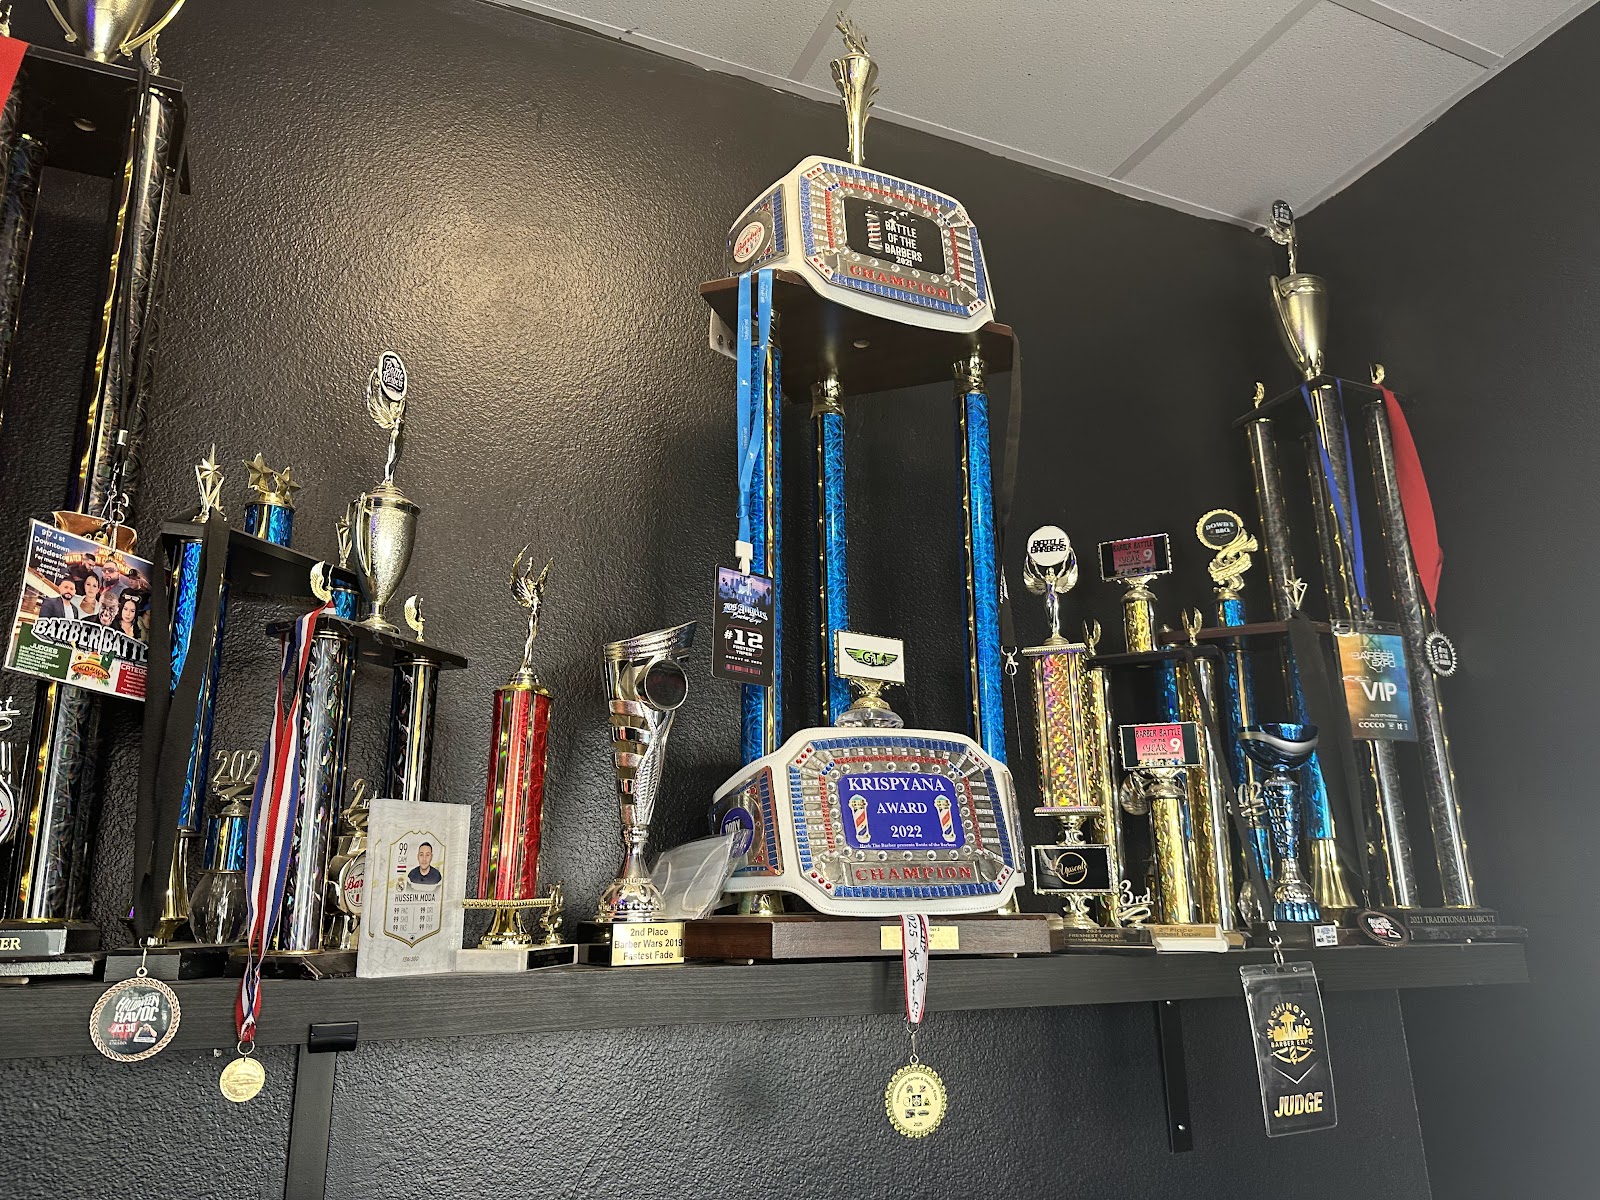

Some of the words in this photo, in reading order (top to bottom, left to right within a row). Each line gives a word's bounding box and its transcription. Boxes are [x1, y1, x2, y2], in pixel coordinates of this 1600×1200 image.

[884, 219, 917, 239] BATTLE
[887, 232, 899, 244] OF
[899, 235, 917, 249] THE
[884, 242, 923, 262] BARBERS
[896, 256, 913, 267] 2021
[850, 265, 949, 299] CHAMPION
[34, 536, 70, 553] Downtown
[1133, 540, 1153, 549] BATTLE
[35, 545, 67, 561] Modesto
[1143, 548, 1153, 561] 9
[34, 619, 101, 651] BARBER
[103, 627, 149, 663] BATTL
[724, 629, 764, 650] #12
[1371, 660, 1396, 668] EXPO
[1361, 681, 1398, 701] VIP
[1135, 729, 1157, 738] BARBER
[1159, 728, 1181, 737] BATTLE
[1142, 743, 1168, 752] YEAR
[1170, 737, 1181, 752] 9
[213, 750, 261, 783] 202
[847, 777, 946, 792] KRISPYANA
[877, 802, 928, 814] AWARD
[890, 825, 923, 838] 2022
[398, 842, 408, 856] 99
[855, 866, 972, 880] CHAMPION
[1119, 879, 1151, 907] 3rd
[906, 914, 918, 938] 025
[1410, 916, 1424, 924] 2021
[1424, 915, 1467, 924] TRADITIONAL
[1467, 915, 1495, 923] HAIRCUT
[630, 928, 645, 937] 2nd
[647, 927, 669, 936] Place
[0, 937, 21, 950] ER
[614, 940, 641, 949] Barber
[643, 939, 663, 948] Wars
[665, 938, 683, 947] 2019
[623, 951, 653, 960] Fastest
[654, 950, 674, 959] Fade
[114, 1006, 160, 1023] HAVOC
[1266, 1002, 1314, 1039] WASHINGTON
[1270, 1040, 1295, 1048] BARBER
[1296, 1038, 1313, 1046] EXPO
[1274, 1091, 1324, 1118] JUDGE
